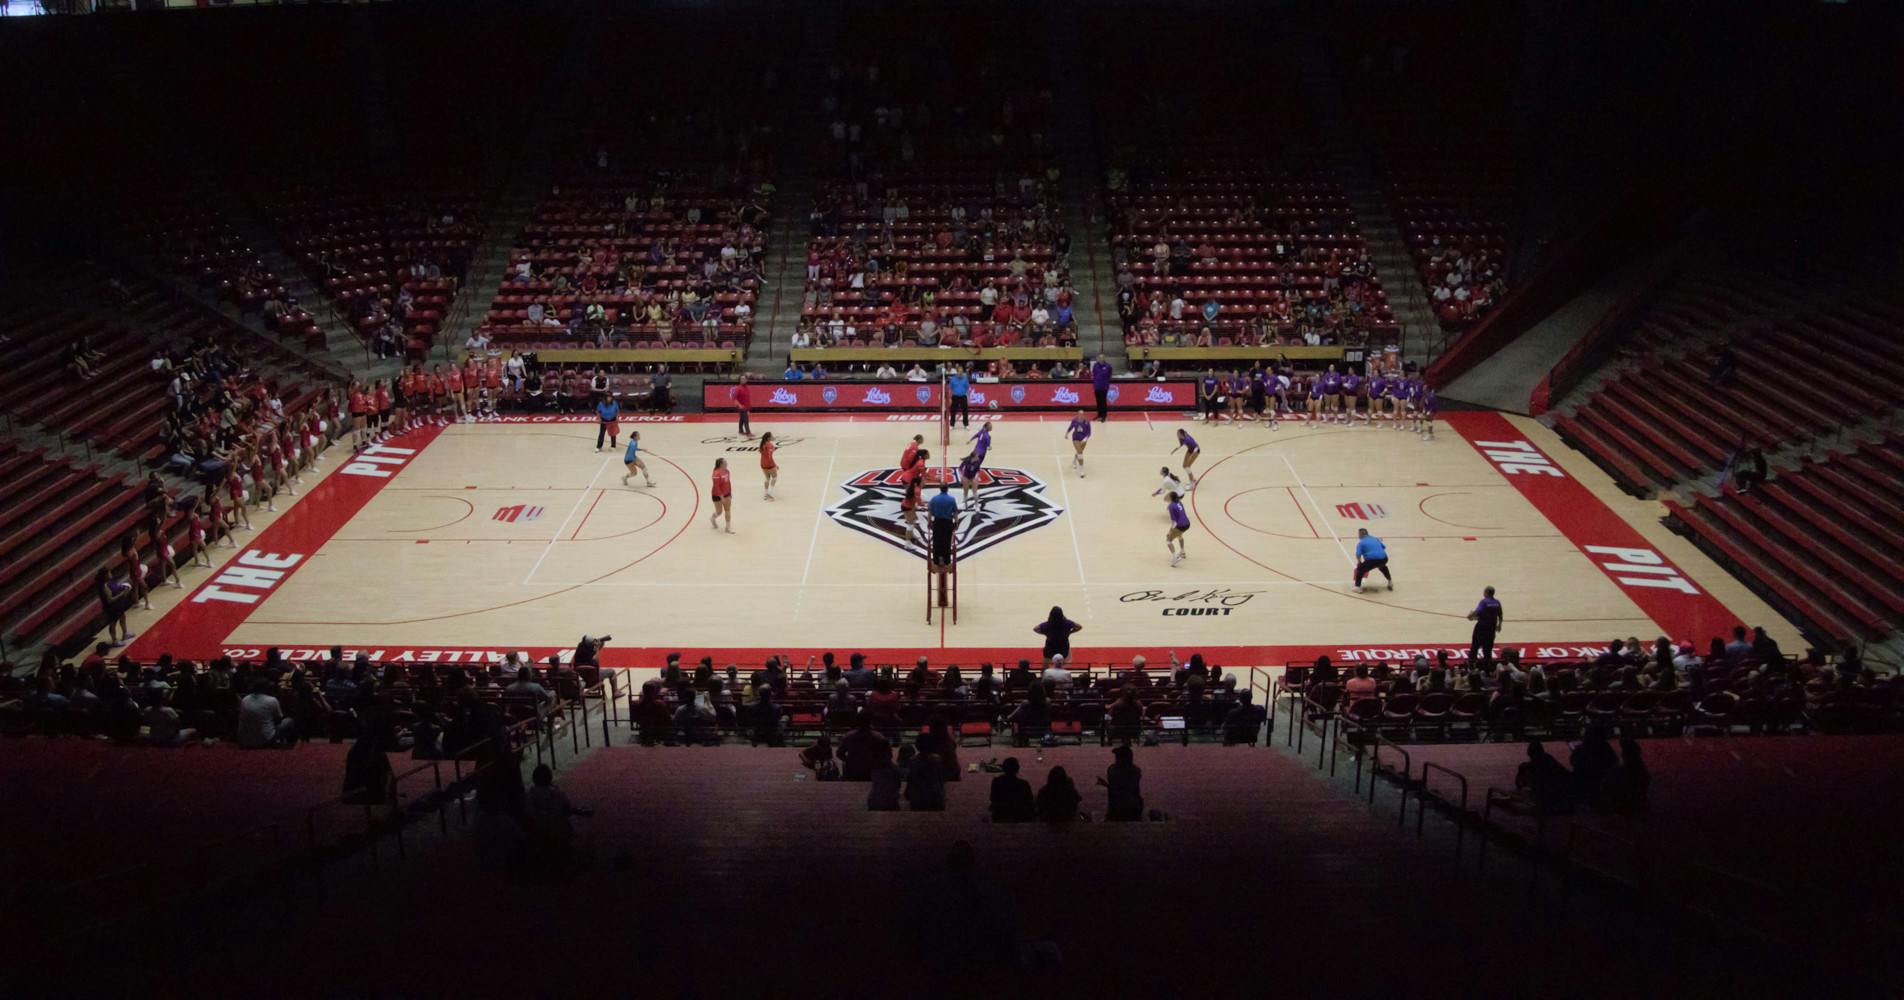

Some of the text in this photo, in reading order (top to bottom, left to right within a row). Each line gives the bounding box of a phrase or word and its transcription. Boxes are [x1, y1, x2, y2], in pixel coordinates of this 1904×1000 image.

[769, 387, 797, 404] Lobos
[862, 387, 891, 404] Lobos
[1051, 386, 1079, 404] Lobos
[1145, 386, 1173, 404] Lobos
[340, 444, 416, 477] PIT
[1474, 440, 1565, 478] THE
[191, 549, 304, 604] THE
[1584, 544, 1701, 595] PIT
[1162, 607, 1234, 616] COURT
